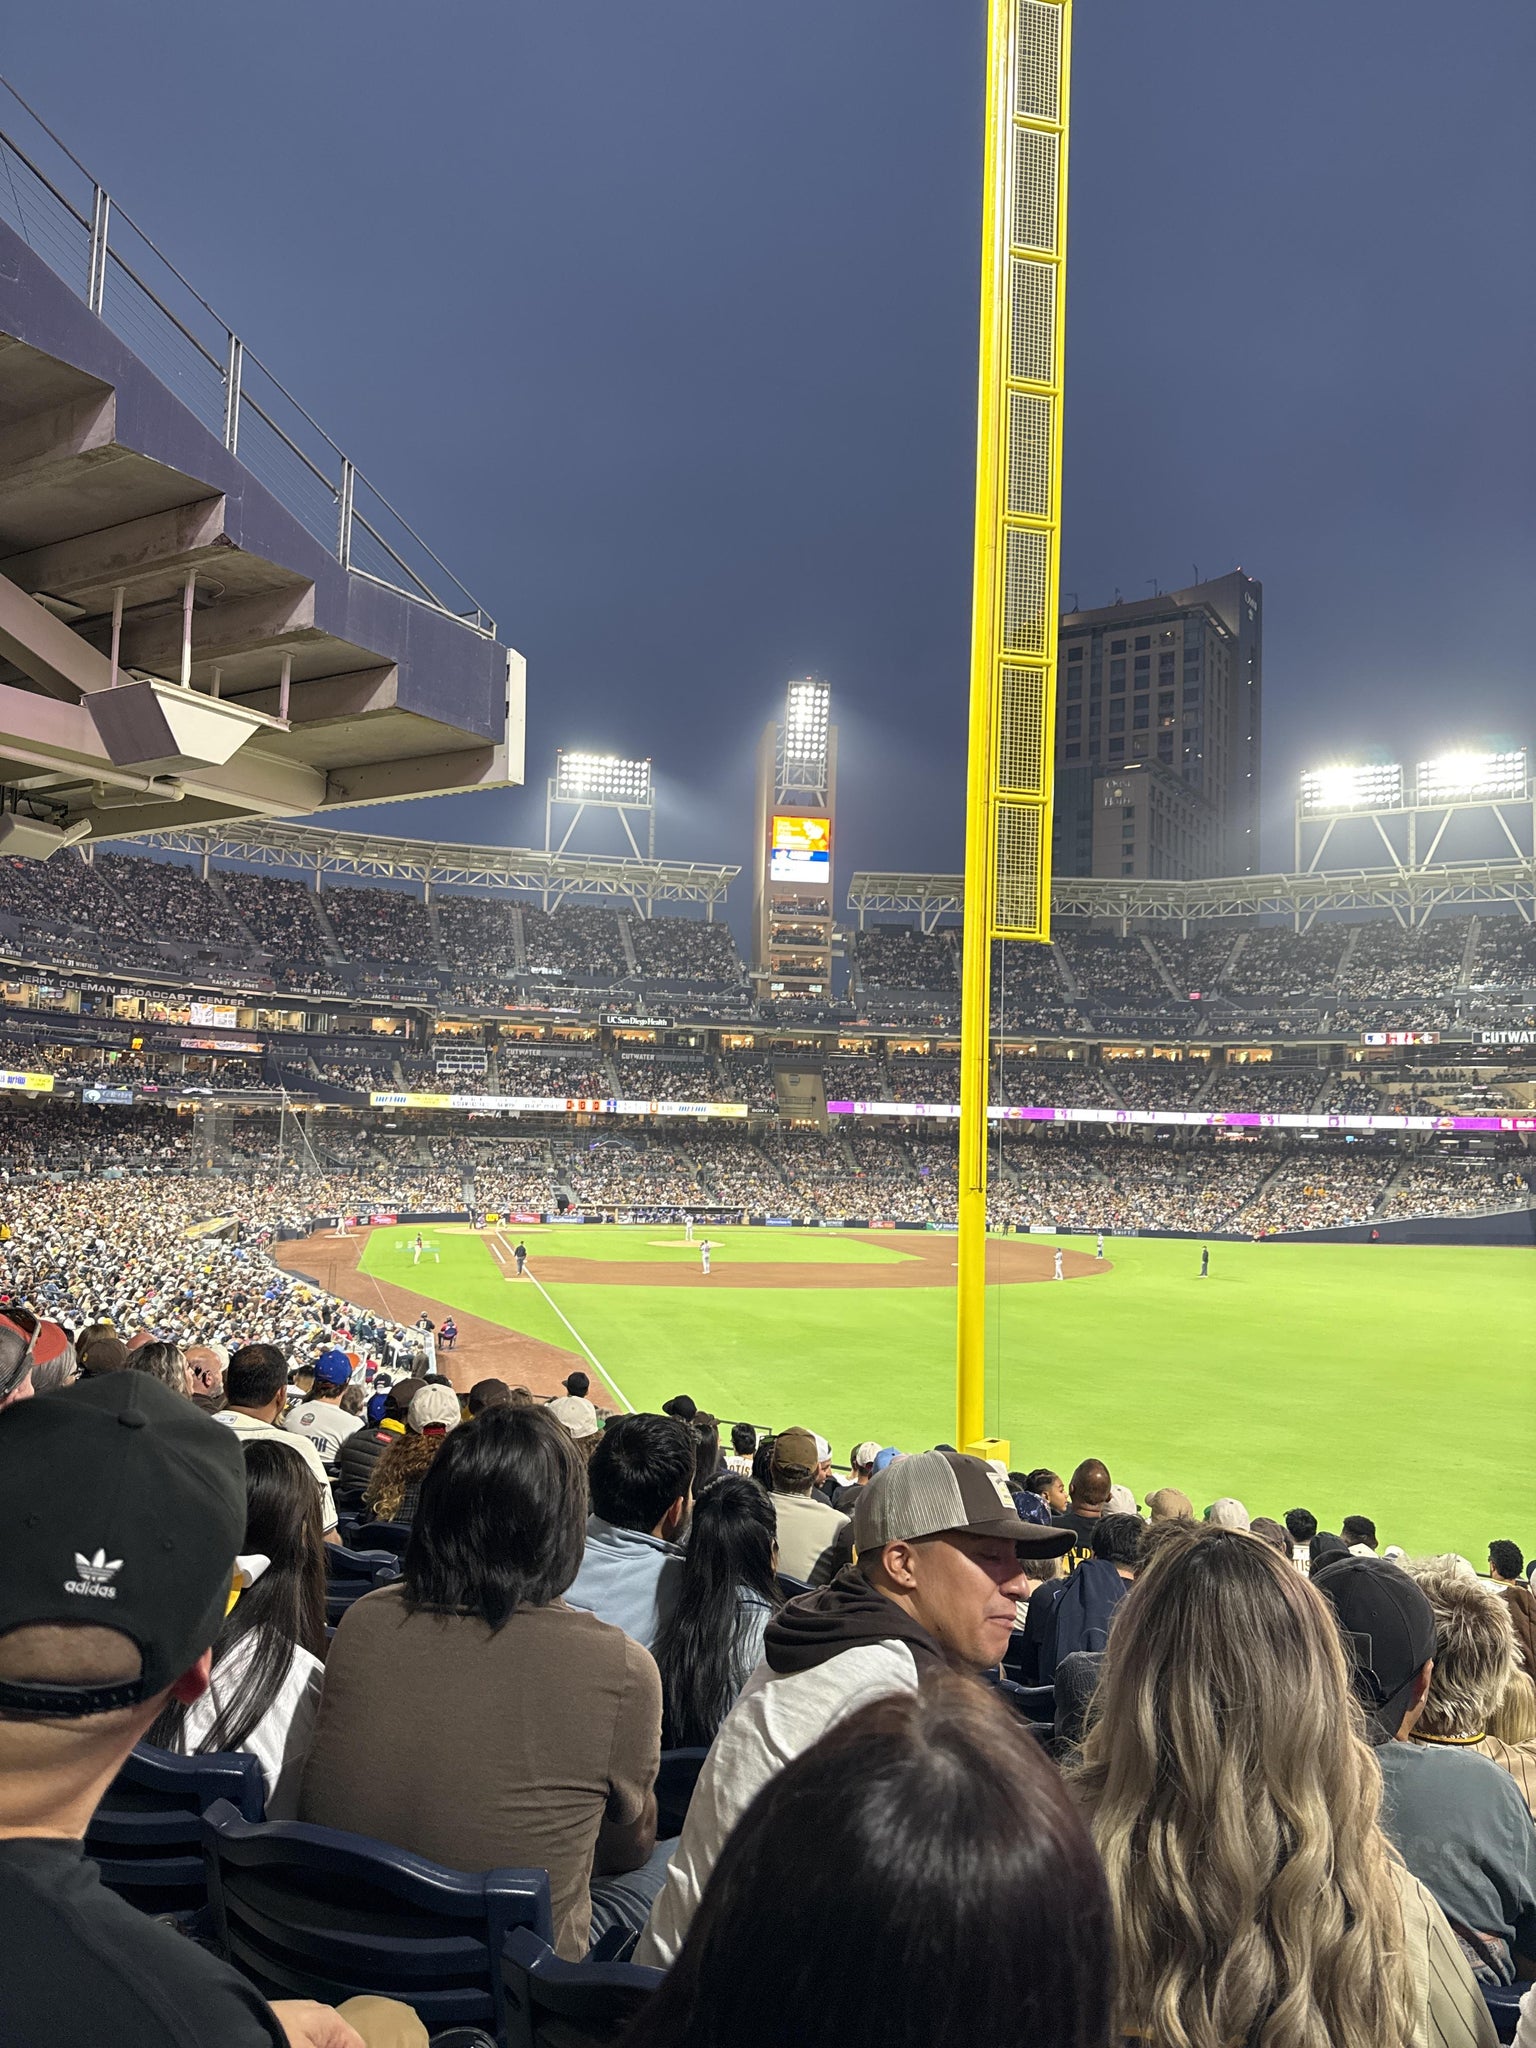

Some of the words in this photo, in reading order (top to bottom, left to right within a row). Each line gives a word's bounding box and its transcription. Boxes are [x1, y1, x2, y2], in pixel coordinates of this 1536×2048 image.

[18, 974, 55, 986] JERRY
[60, 979, 116, 993] COLEMAN
[120, 987, 193, 1001] BROADCAST
[198, 995, 246, 1006] CENTER
[607, 1015, 618, 1024] UC
[618, 1016, 630, 1024] San
[630, 1017, 648, 1026] Diego
[648, 1017, 668, 1026] Health
[1481, 1030, 1536, 1044] CUTWAT
[506, 1048, 542, 1056] CUTWATER
[621, 1052, 655, 1061] CUTWATER
[63, 1580, 117, 1600] adidas
